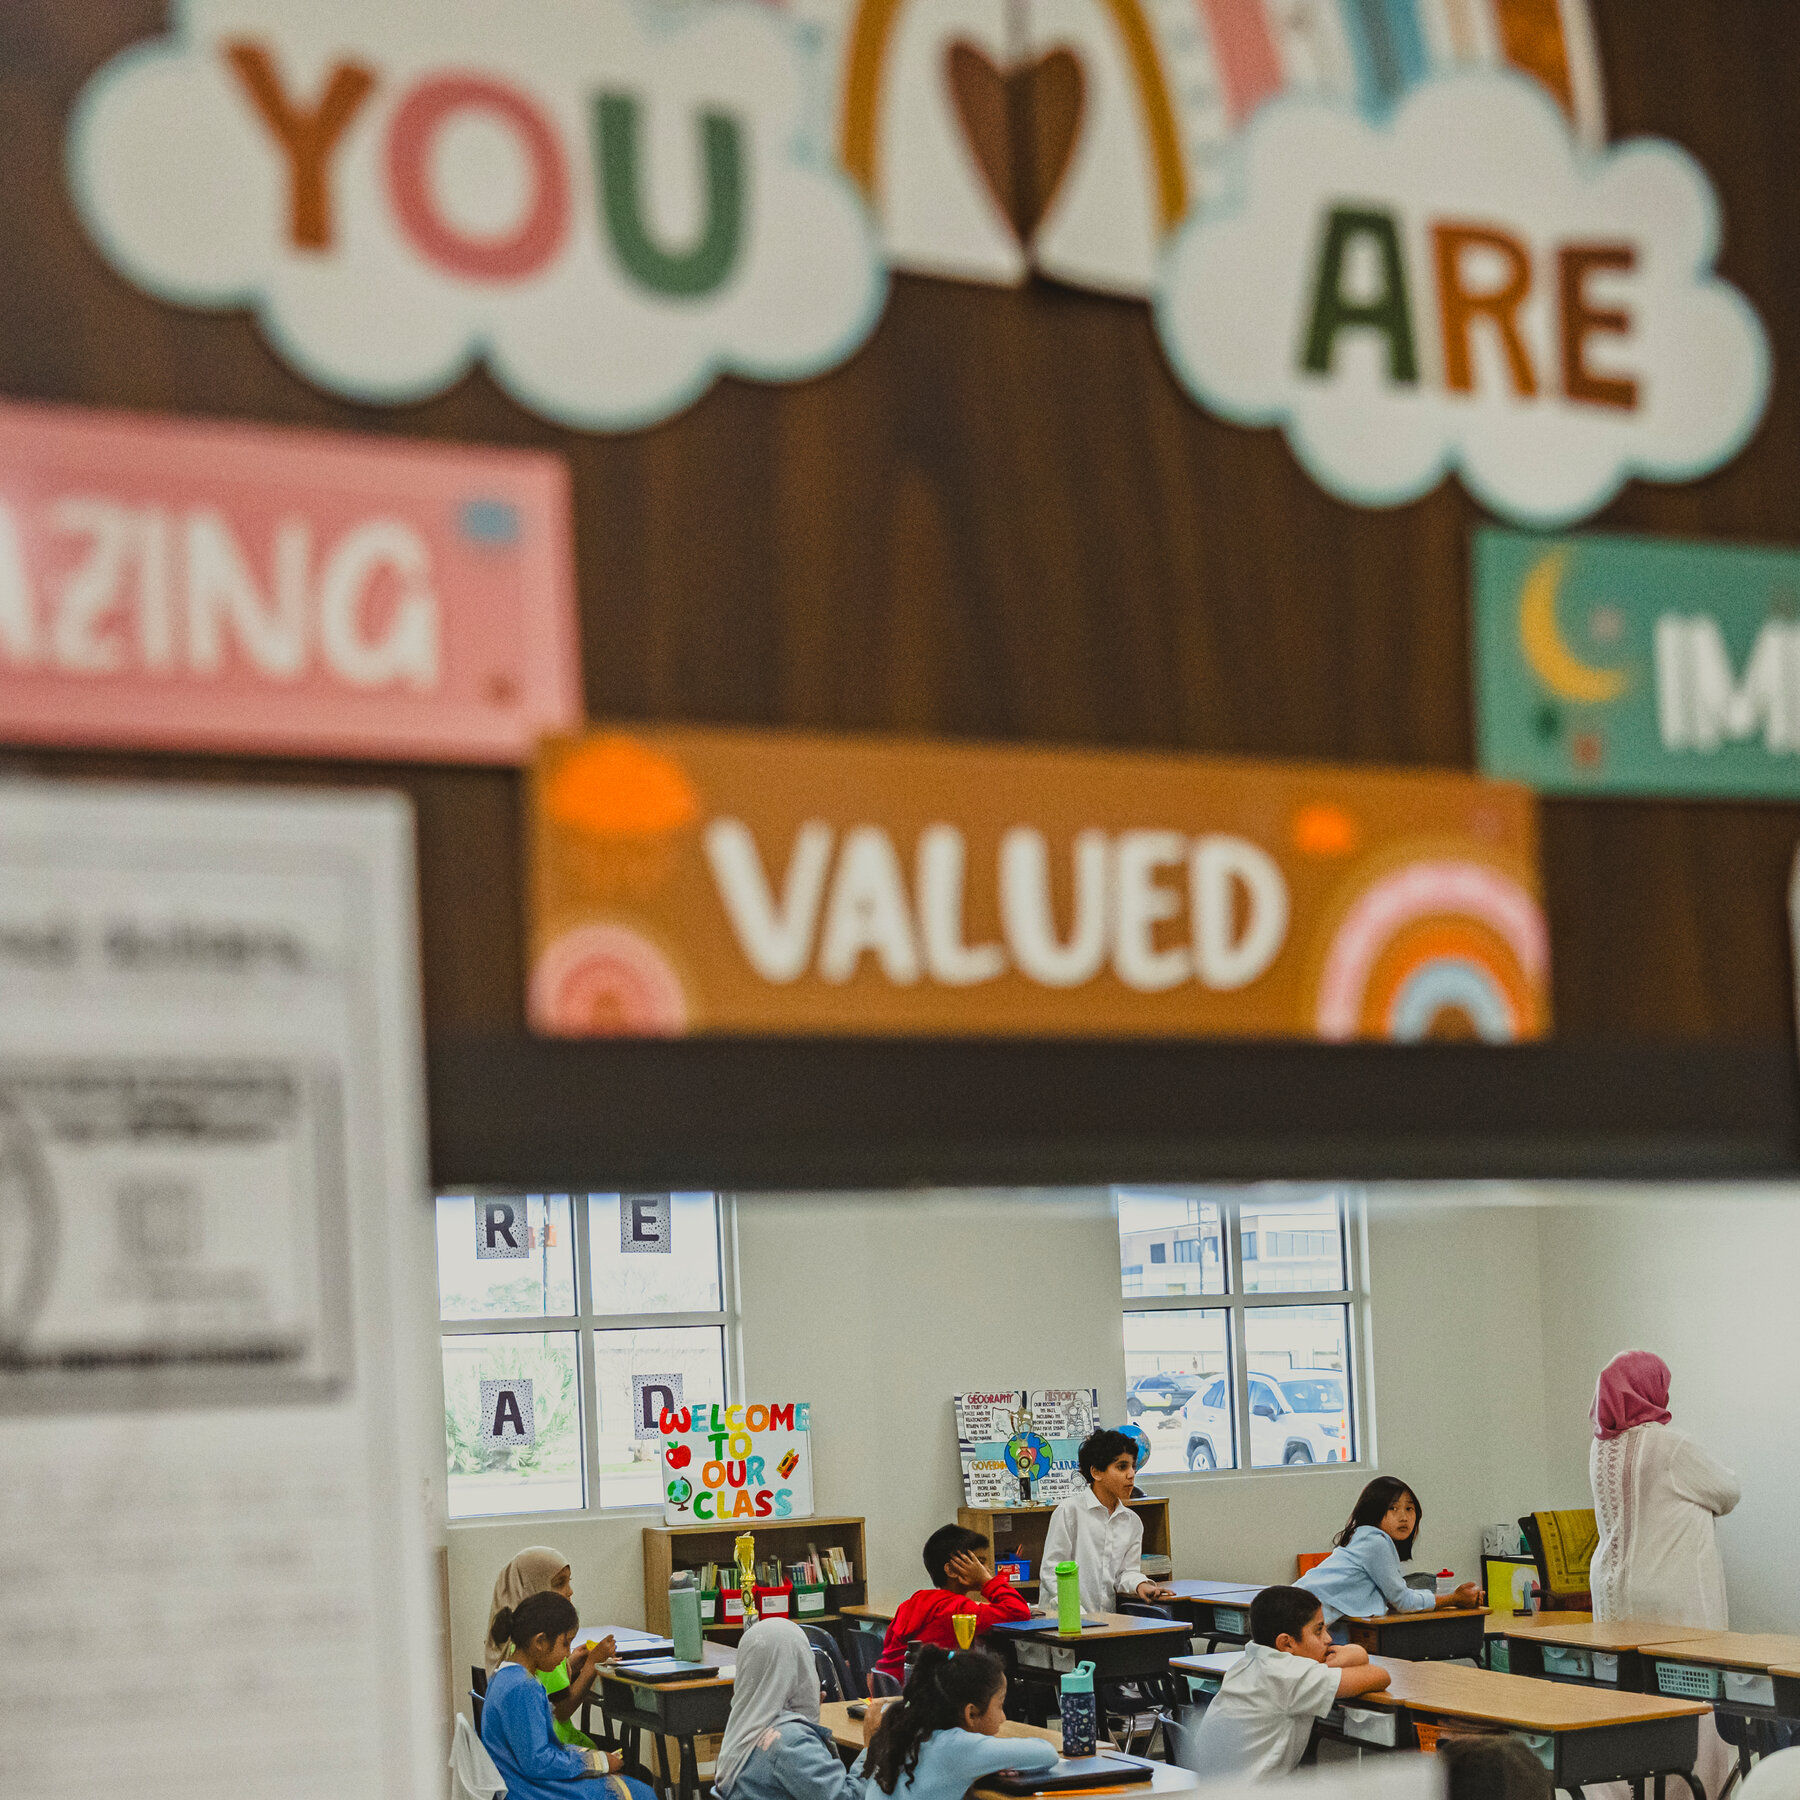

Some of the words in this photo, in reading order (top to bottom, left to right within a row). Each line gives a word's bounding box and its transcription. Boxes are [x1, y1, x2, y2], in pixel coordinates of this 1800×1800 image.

[222, 41, 747, 303] YOU
[1298, 203, 1641, 411] ARE
[704, 817, 1288, 991] VALUED
[485, 1203, 518, 1249] R
[631, 1200, 660, 1242] E
[492, 1390, 525, 1436] A
[967, 1394, 1014, 1404] GEOGRAPHY
[1045, 1392, 1077, 1401] HISTORY
[659, 1403, 810, 1434] WELCOME
[708, 1432, 752, 1461] TO
[702, 1455, 766, 1488] OUR
[693, 1488, 793, 1520] CLASS
